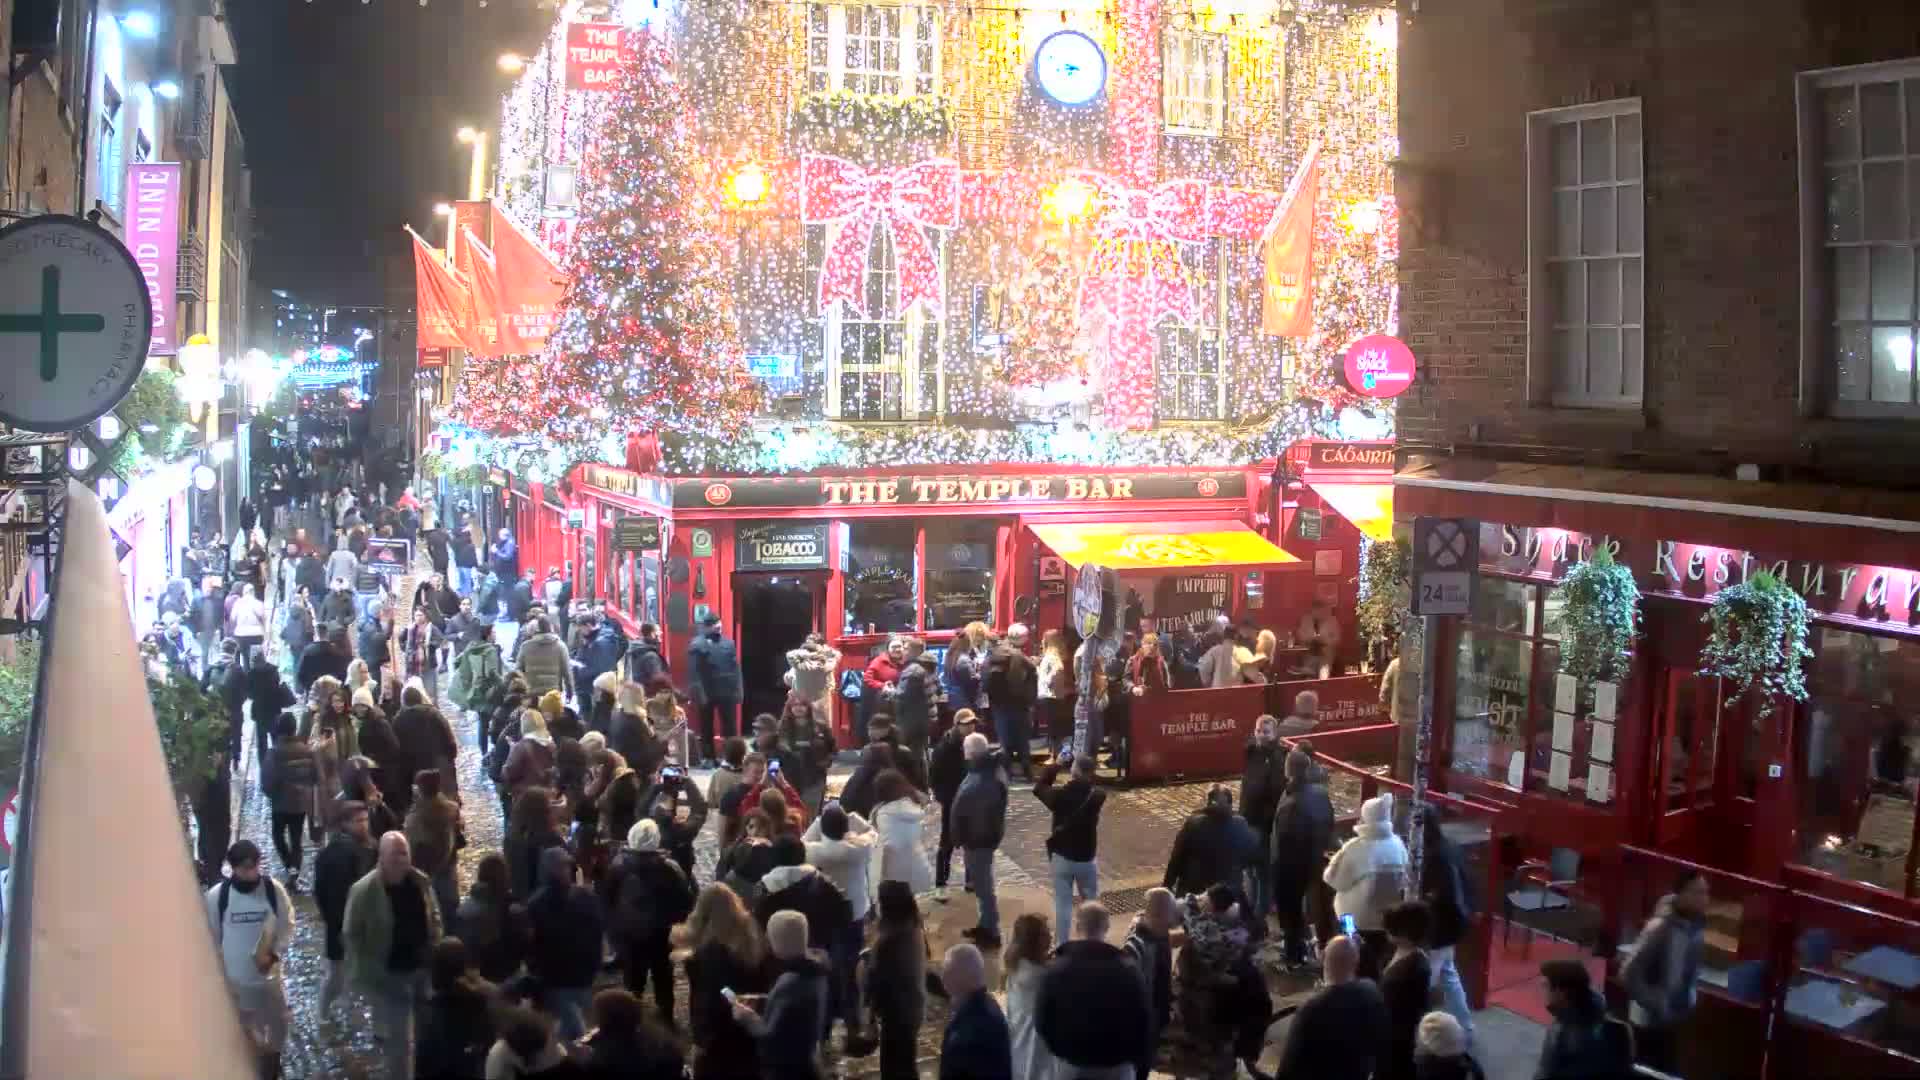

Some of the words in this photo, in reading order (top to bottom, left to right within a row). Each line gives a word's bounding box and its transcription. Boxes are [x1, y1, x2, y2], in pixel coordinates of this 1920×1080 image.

[585, 28, 618, 46] THE
[136, 171, 170, 232] NINE
[823, 478, 899, 504] THE
[912, 478, 1051, 503] TEMPLE
[1065, 477, 1134, 500] BAR
[750, 538, 817, 562] TOBACCO
[1176, 577, 1227, 593] EMPEROR
[1423, 584, 1443, 601] 24
[1160, 721, 1209, 737] TEMPLE
